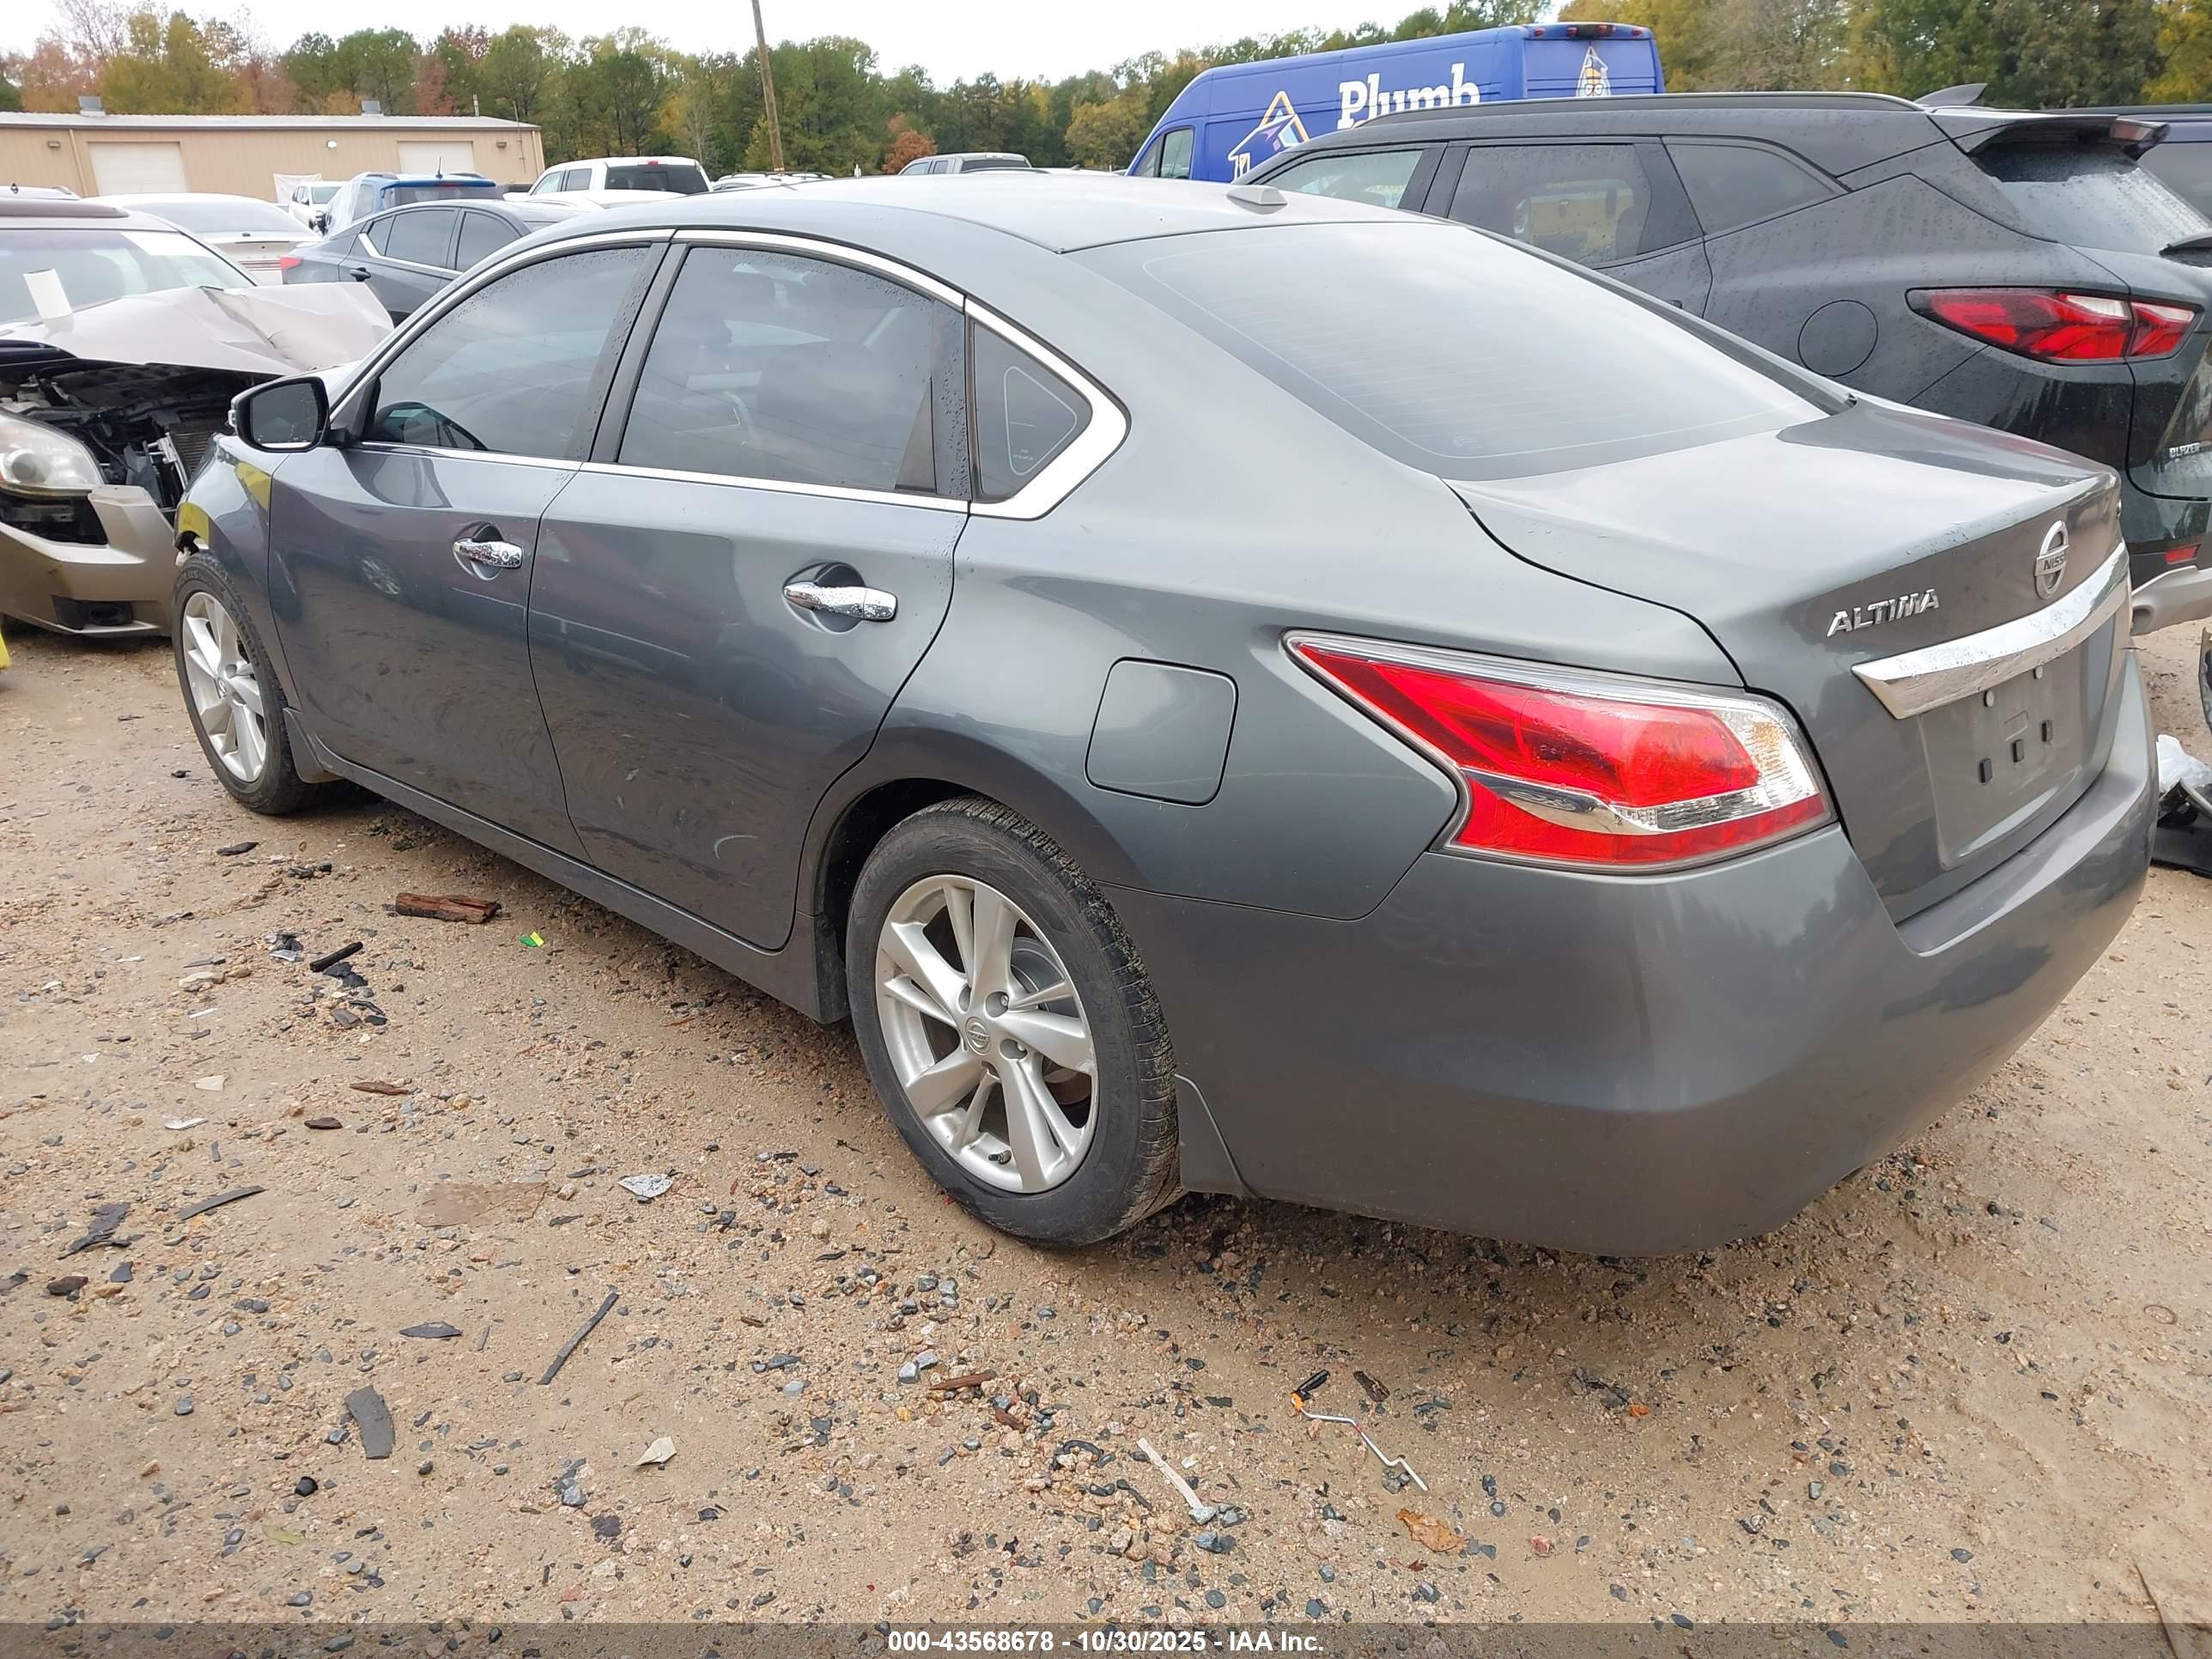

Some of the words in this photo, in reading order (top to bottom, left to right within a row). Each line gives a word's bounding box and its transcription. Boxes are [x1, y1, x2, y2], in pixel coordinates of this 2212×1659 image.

[1337, 62, 1480, 130] Plumb
[2169, 442, 2200, 459] BLAZER
[2043, 550, 2068, 571] NISS
[1826, 588, 1940, 637] ALTIMA
